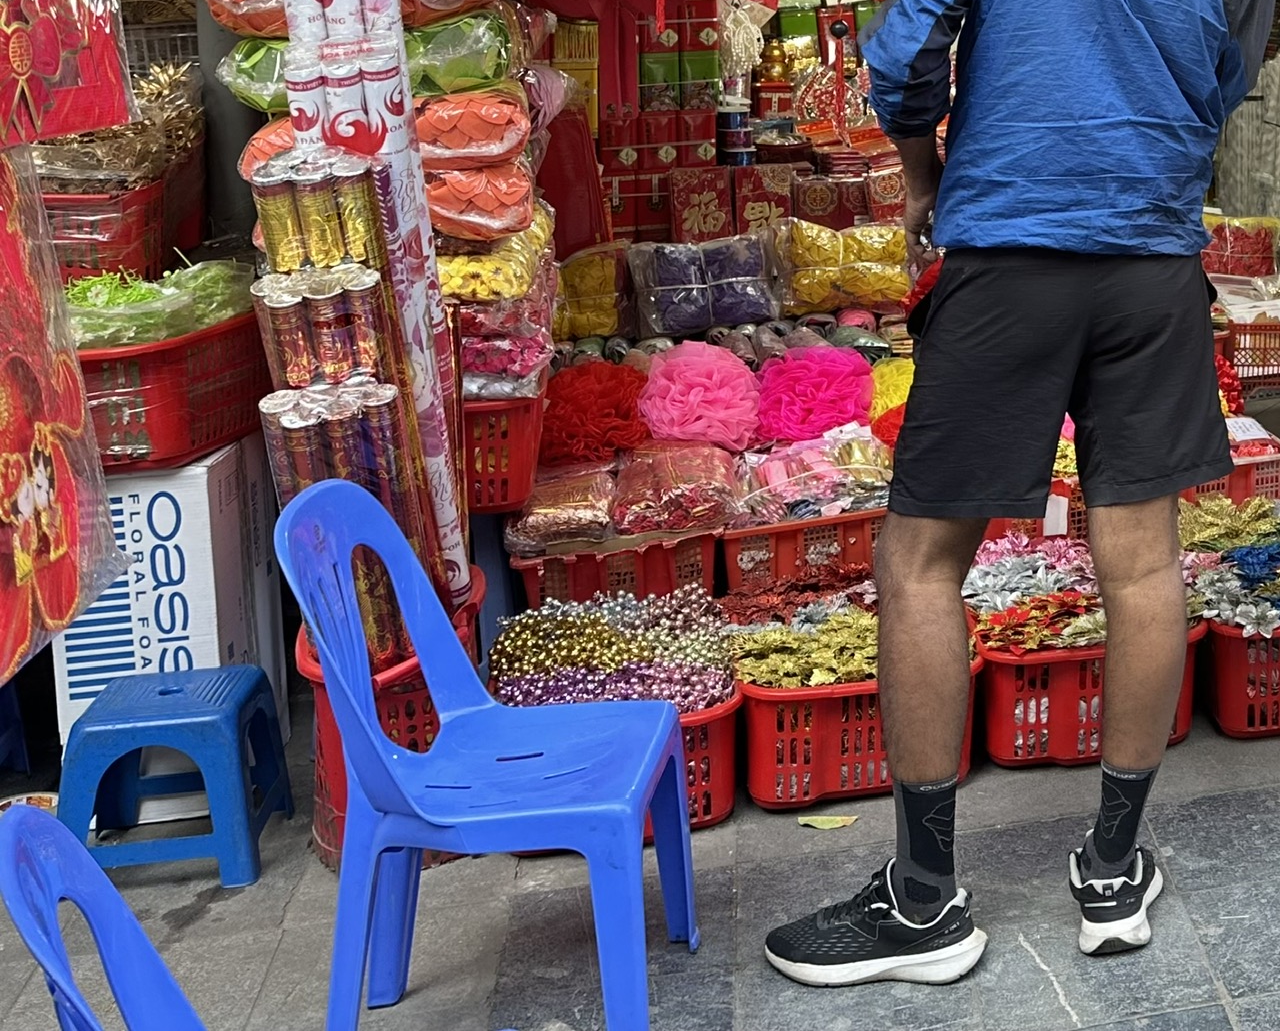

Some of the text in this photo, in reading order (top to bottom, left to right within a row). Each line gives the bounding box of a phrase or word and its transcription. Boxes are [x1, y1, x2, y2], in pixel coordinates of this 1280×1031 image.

[307, 13, 324, 24] HO
[682, 191, 726, 236] 福
[128, 493, 153, 670] FLORAL FOA
